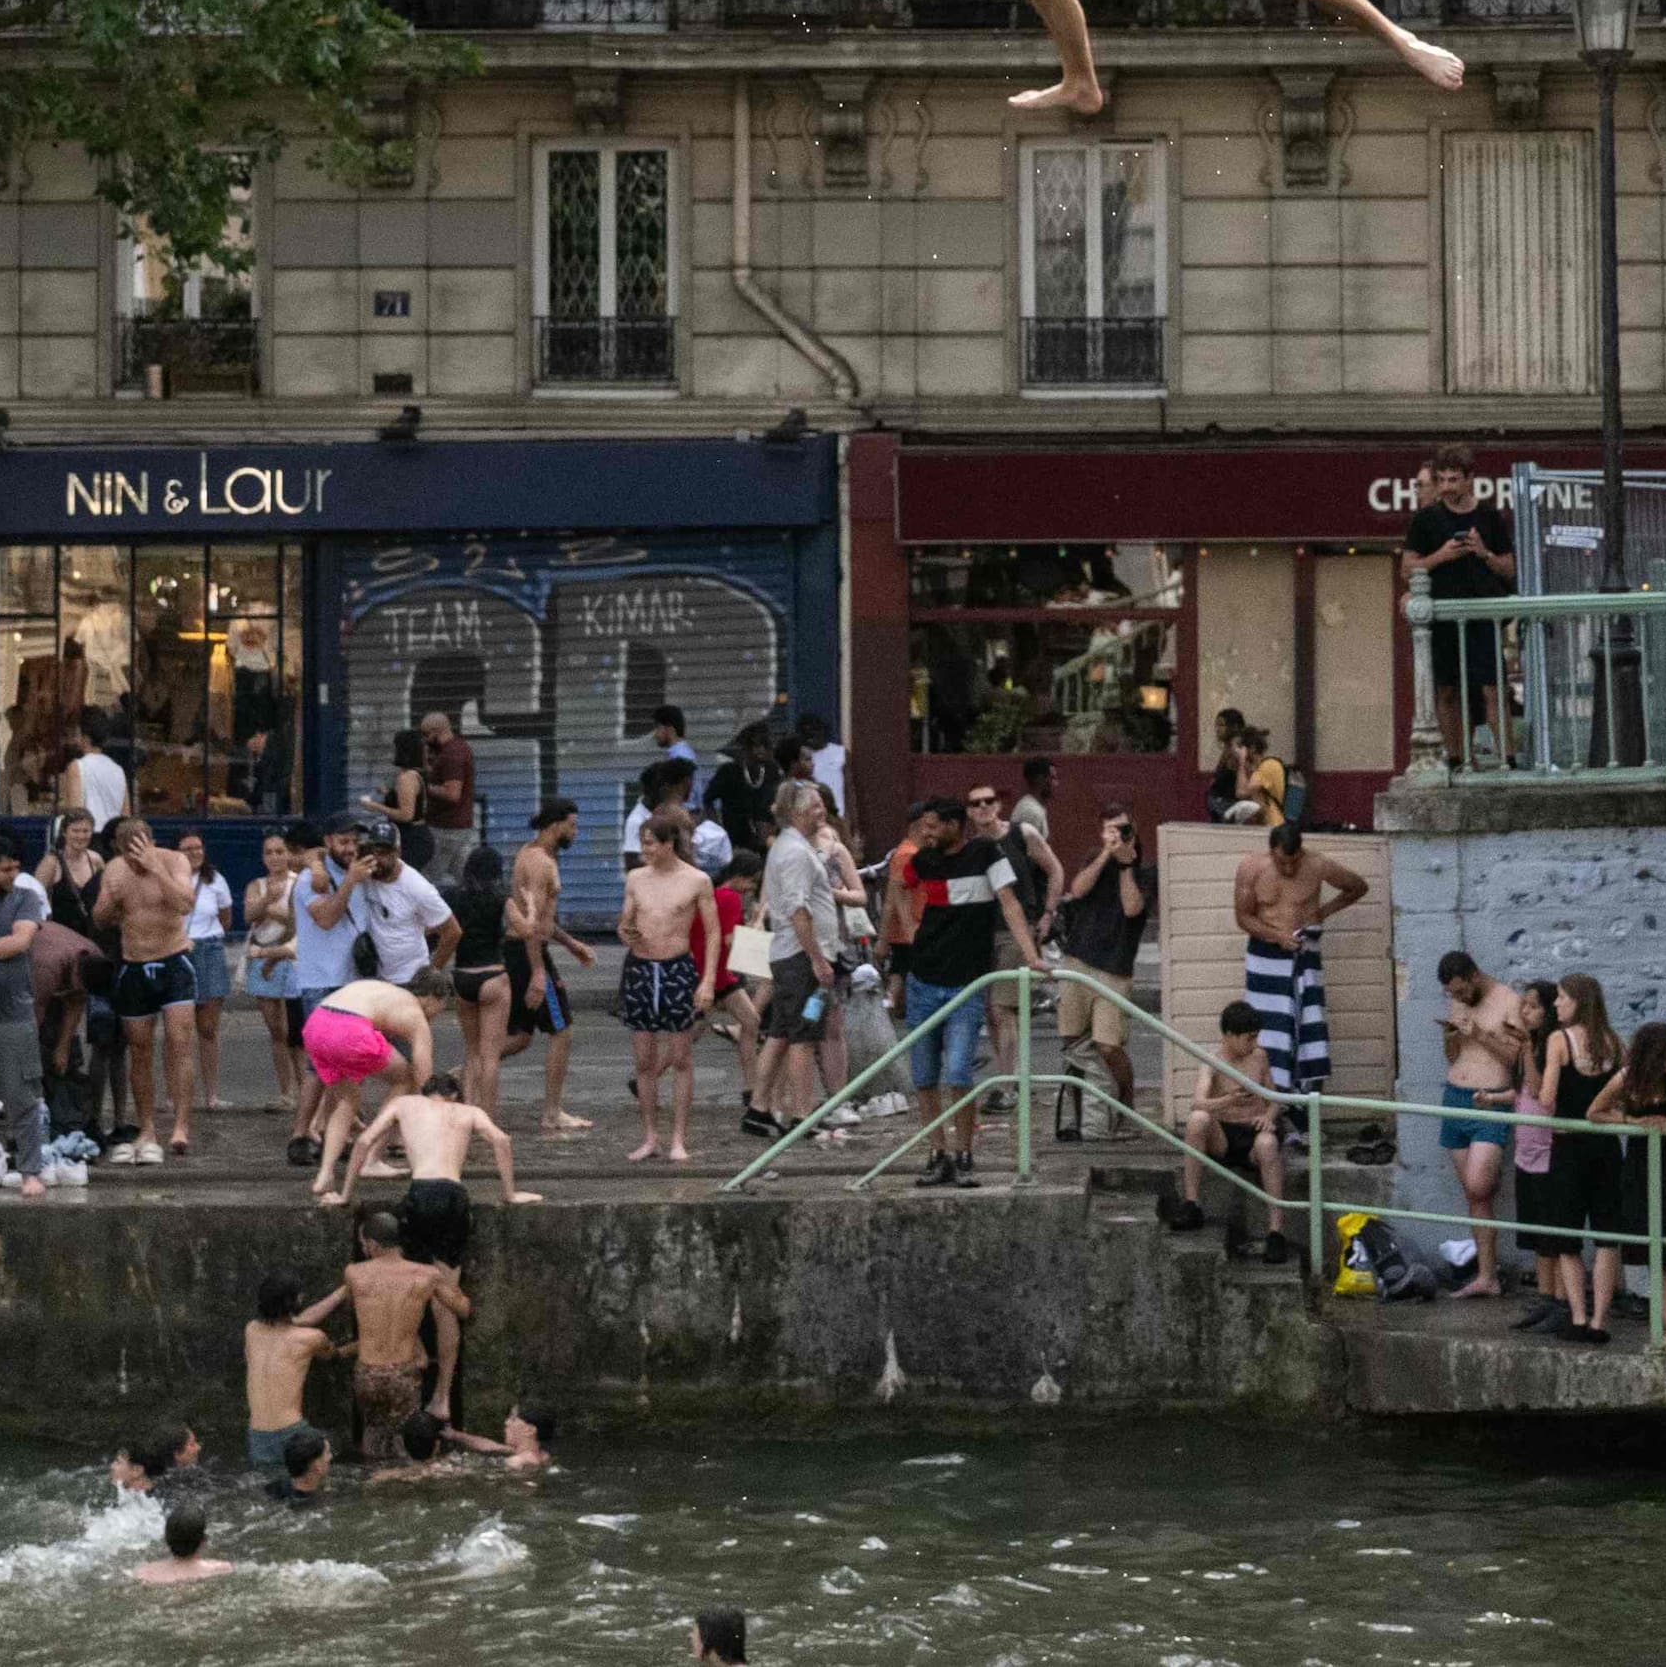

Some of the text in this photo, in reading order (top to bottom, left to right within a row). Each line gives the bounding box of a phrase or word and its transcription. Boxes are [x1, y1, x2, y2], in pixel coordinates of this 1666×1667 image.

[66, 452, 332, 515] NIN & Laur
[1473, 477, 1593, 510] PRNE
